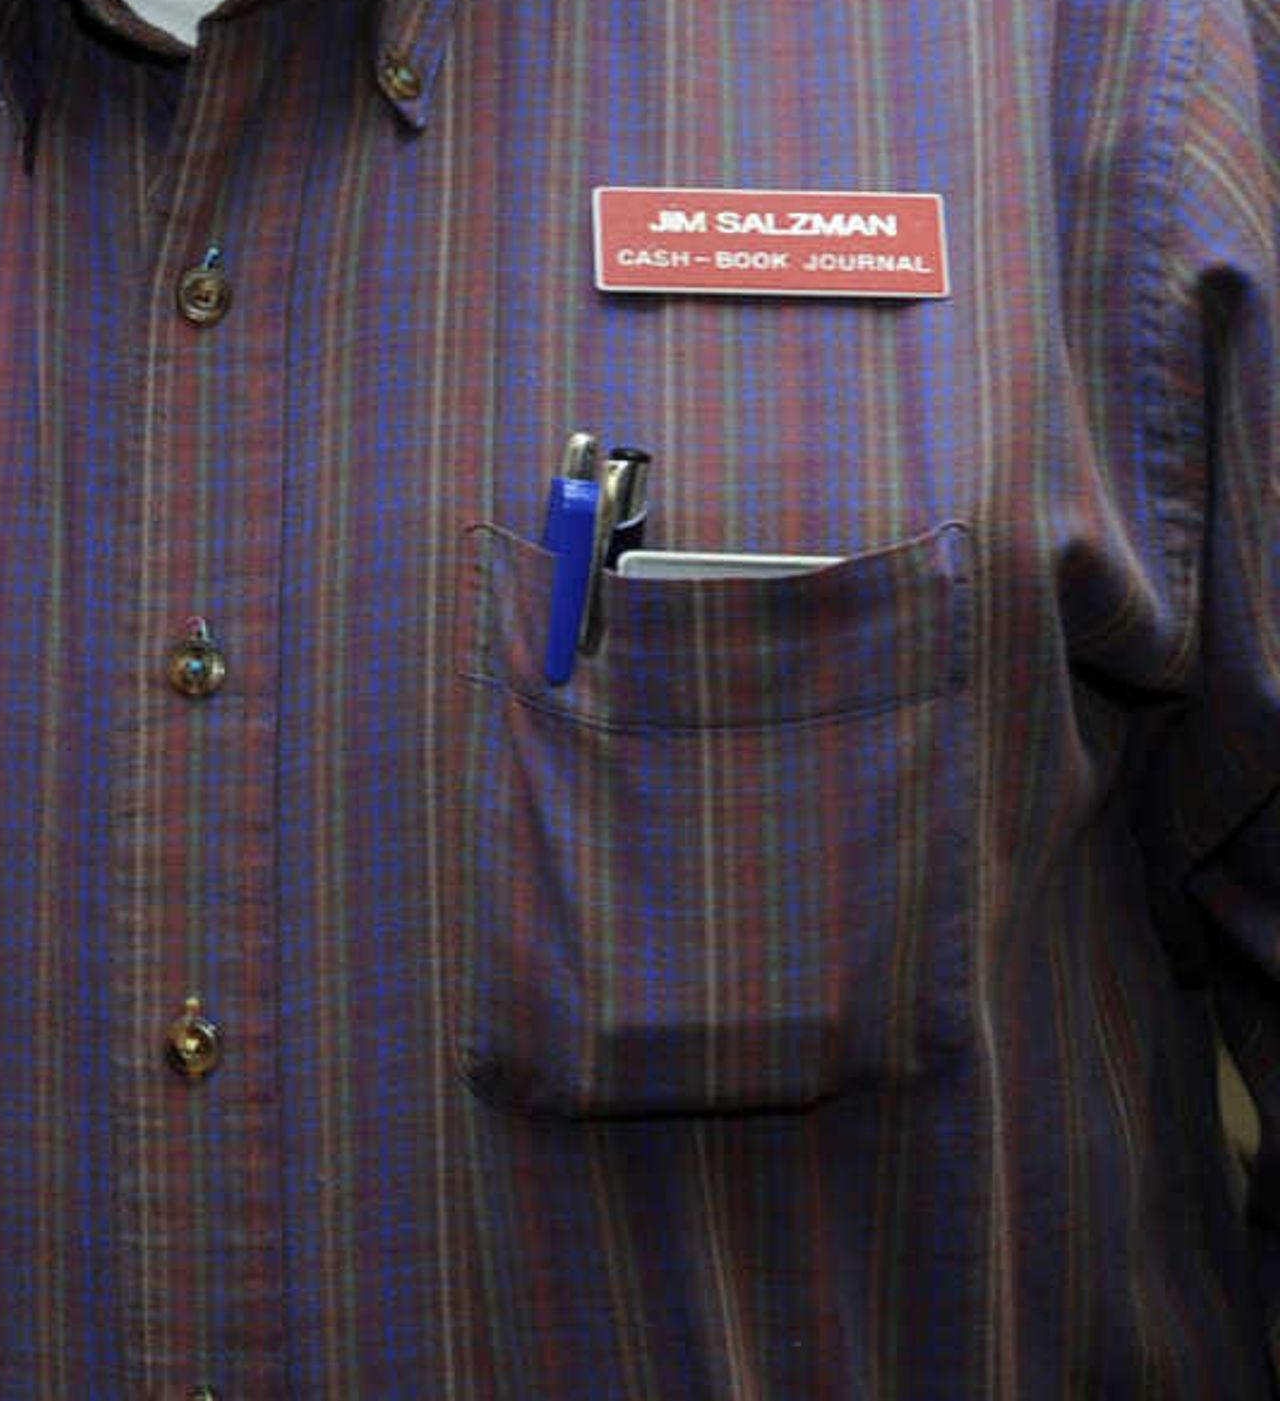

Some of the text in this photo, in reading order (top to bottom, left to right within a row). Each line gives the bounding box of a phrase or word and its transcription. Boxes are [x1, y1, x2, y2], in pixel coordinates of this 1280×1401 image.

[648, 210, 898, 237] JIM SALZMAN
[802, 252, 933, 274] JOURNAL
